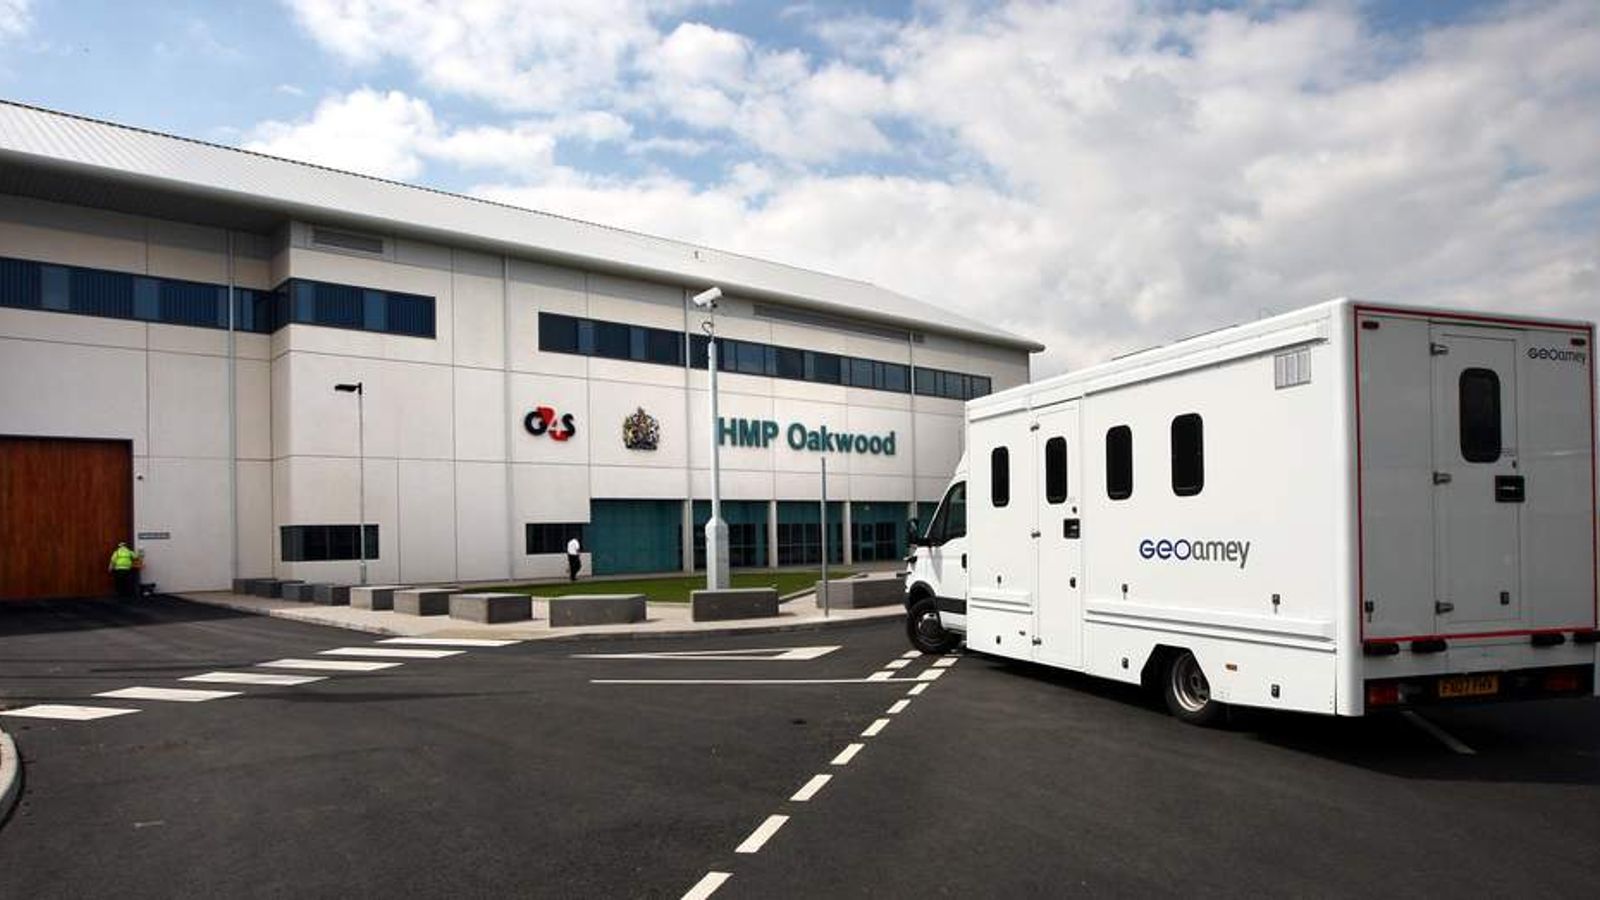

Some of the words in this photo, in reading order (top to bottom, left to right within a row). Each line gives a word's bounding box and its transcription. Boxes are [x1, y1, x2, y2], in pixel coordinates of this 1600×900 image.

[524, 406, 576, 441] G4S
[717, 416, 780, 449] HMP
[786, 422, 897, 456] Oakwood
